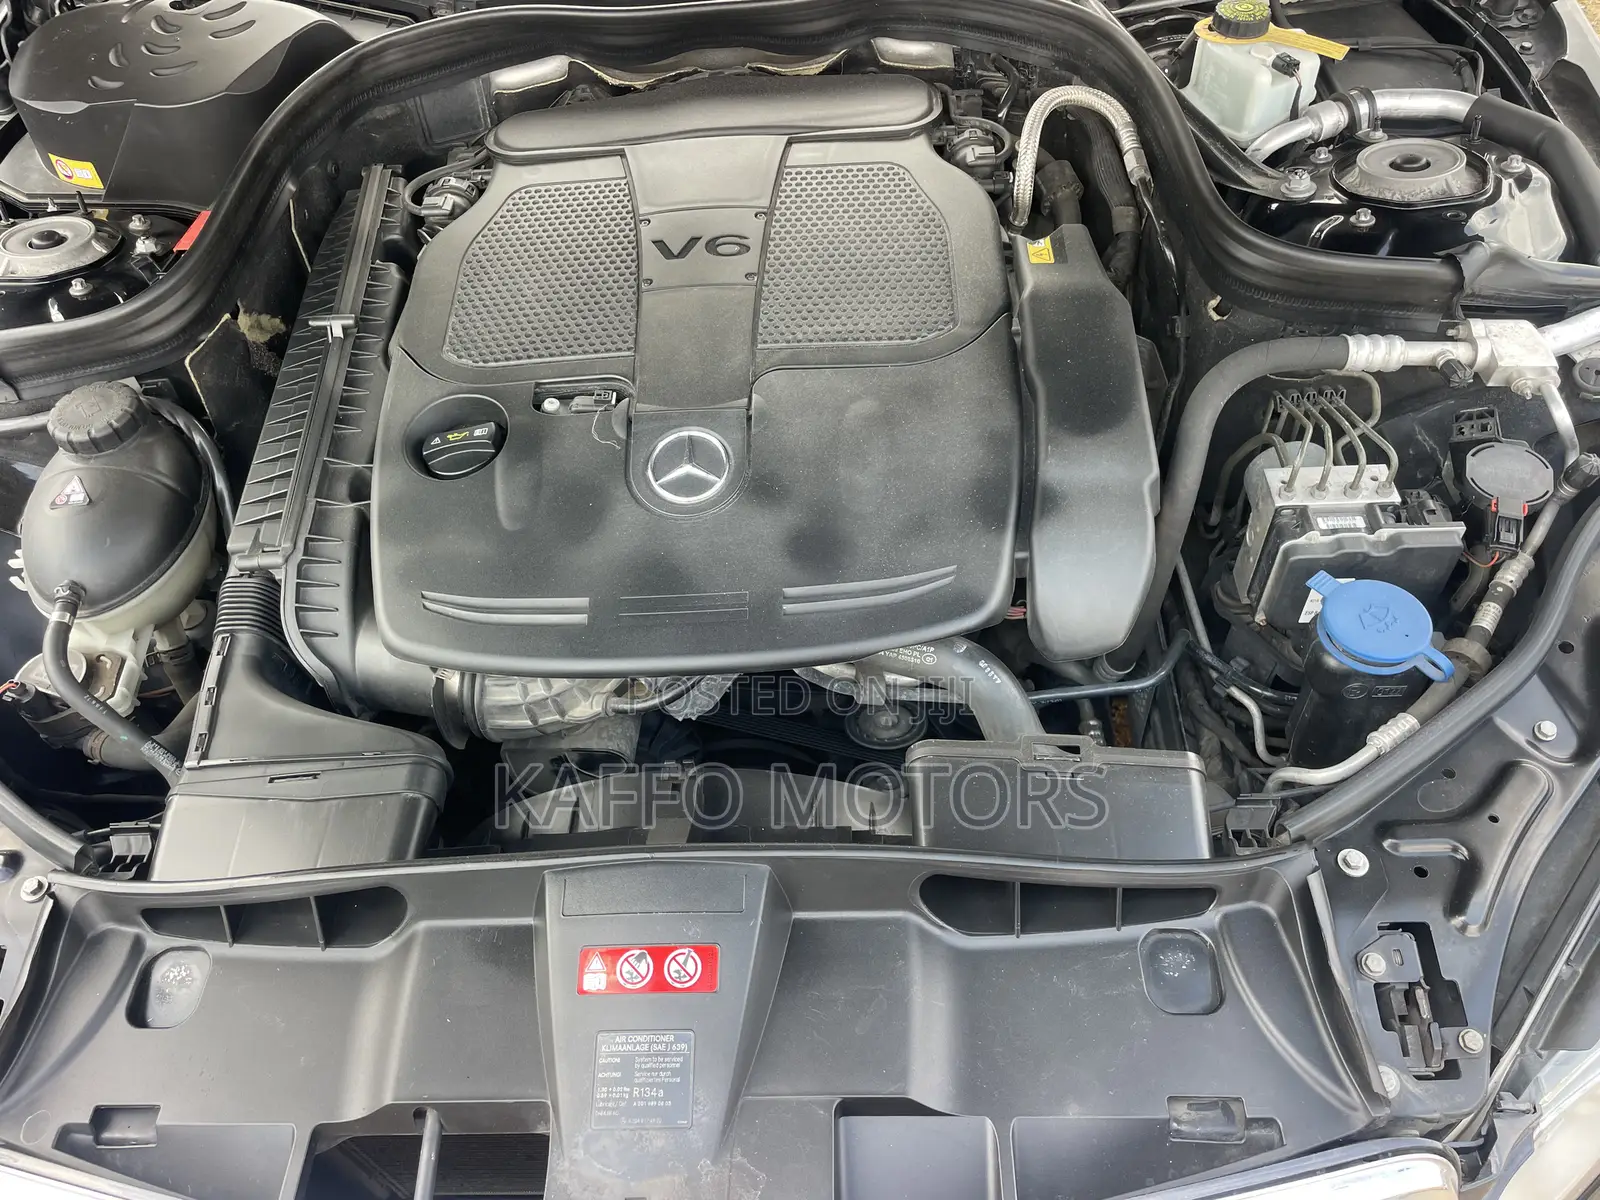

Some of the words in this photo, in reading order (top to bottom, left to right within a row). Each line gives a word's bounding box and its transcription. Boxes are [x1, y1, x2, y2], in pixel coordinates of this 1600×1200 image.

[651, 234, 751, 260] V6
[615, 1035, 627, 1043] AIR
[627, 1034, 675, 1043] CONDITIONER
[601, 1043, 650, 1052] KLIMAANLAGE
[650, 1043, 666, 1053] (SAE
[632, 1086, 664, 1098] R134a
